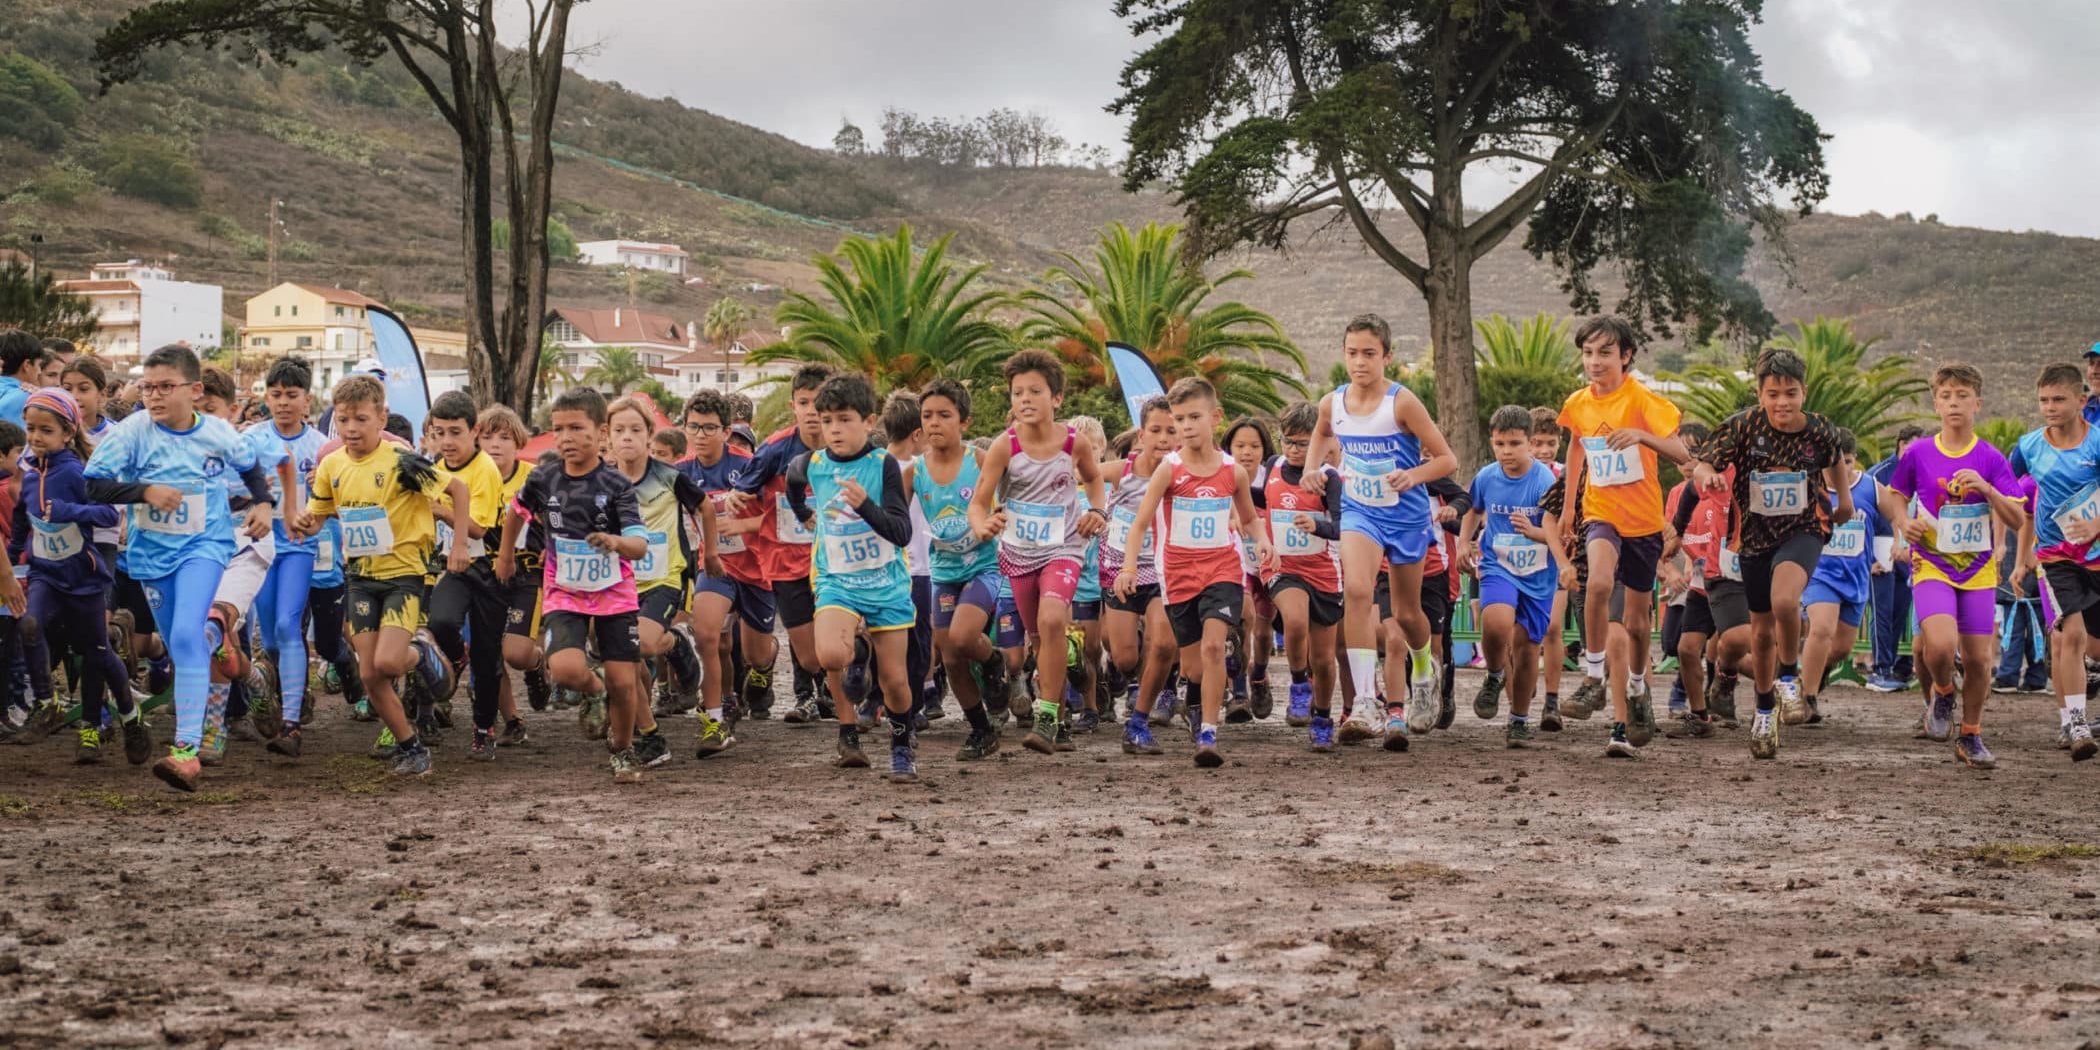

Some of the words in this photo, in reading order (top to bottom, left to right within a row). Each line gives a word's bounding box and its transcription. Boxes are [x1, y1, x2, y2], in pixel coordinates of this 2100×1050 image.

[1593, 453, 1628, 478] 974
[1353, 477, 1384, 499] 481
[1762, 487, 1797, 508] 975
[345, 524, 379, 549] 219
[1015, 519, 1050, 542] 594
[1190, 516, 1216, 539] 69
[1285, 527, 1309, 547] 63
[1951, 521, 1983, 545] 343
[39, 532, 70, 554] 741
[839, 536, 881, 563] 155
[1828, 533, 1856, 550] 340
[565, 552, 612, 582] 1788
[1507, 549, 1537, 569] 482
